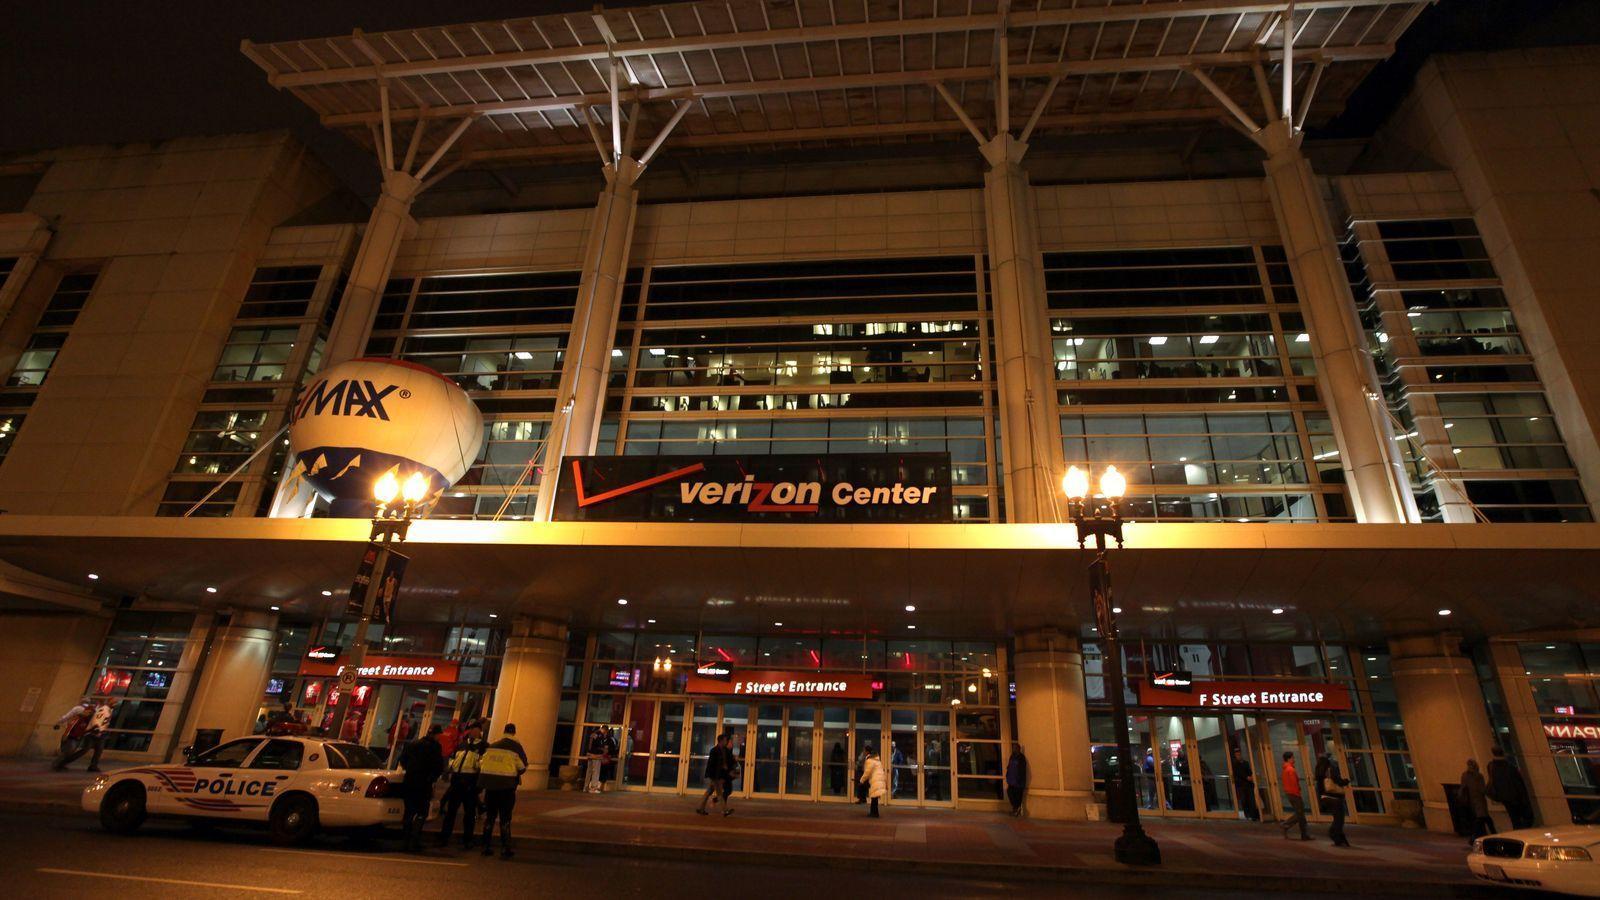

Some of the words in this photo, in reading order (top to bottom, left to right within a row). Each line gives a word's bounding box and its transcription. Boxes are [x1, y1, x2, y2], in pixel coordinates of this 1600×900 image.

[680, 474, 822, 512] verizon
[831, 481, 937, 505] Center
[336, 665, 346, 677] F
[355, 666, 381, 676] reet
[382, 665, 435, 676] Entrance
[734, 682, 743, 694] F
[745, 681, 786, 694] Street
[788, 680, 847, 693] Entrance
[1199, 693, 1208, 706] F
[1211, 693, 1257, 706] Street
[1260, 691, 1324, 704] Entrance
[193, 778, 277, 797] POLICE
